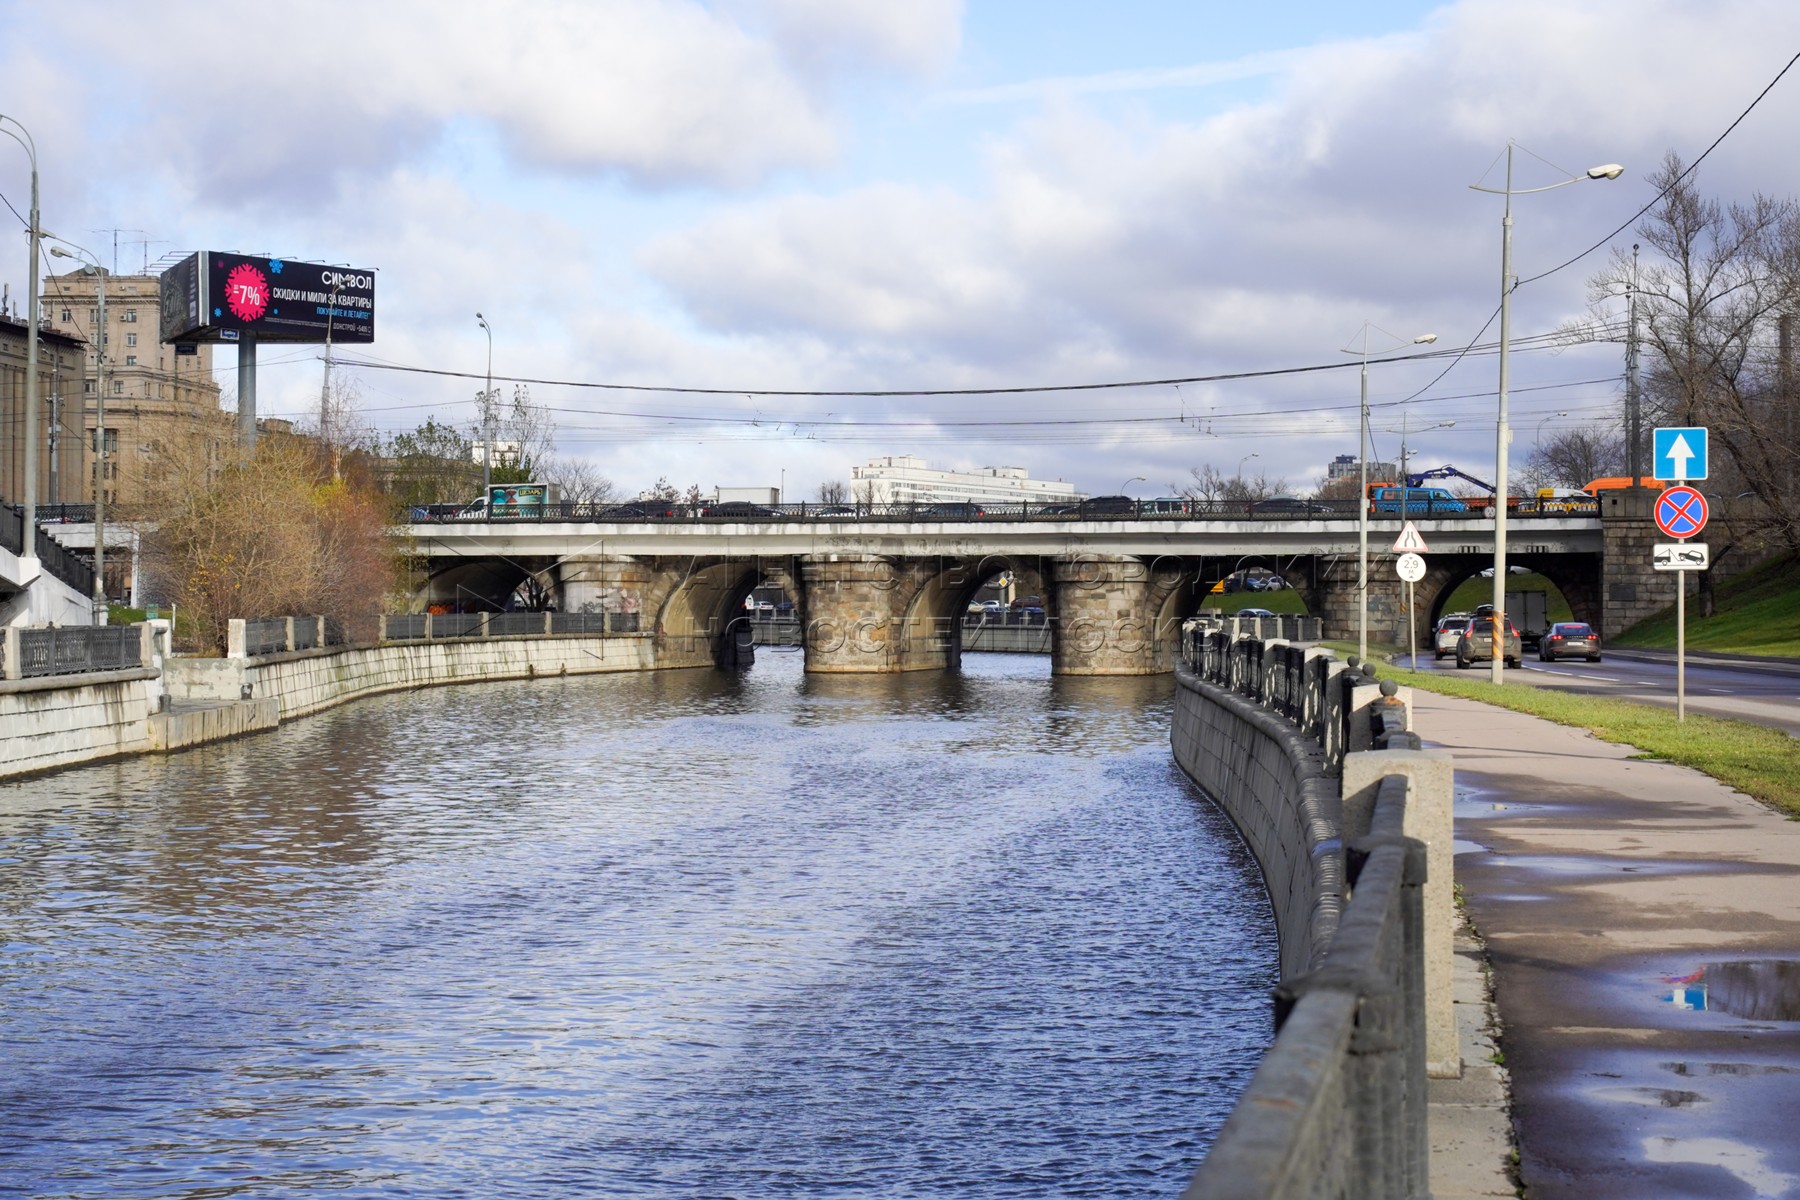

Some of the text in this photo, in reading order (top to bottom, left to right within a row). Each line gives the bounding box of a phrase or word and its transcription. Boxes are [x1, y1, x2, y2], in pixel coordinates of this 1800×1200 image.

[273, 287, 372, 309] СКИДКИ И МИЛИ ЗА КВАРТИРЫ
